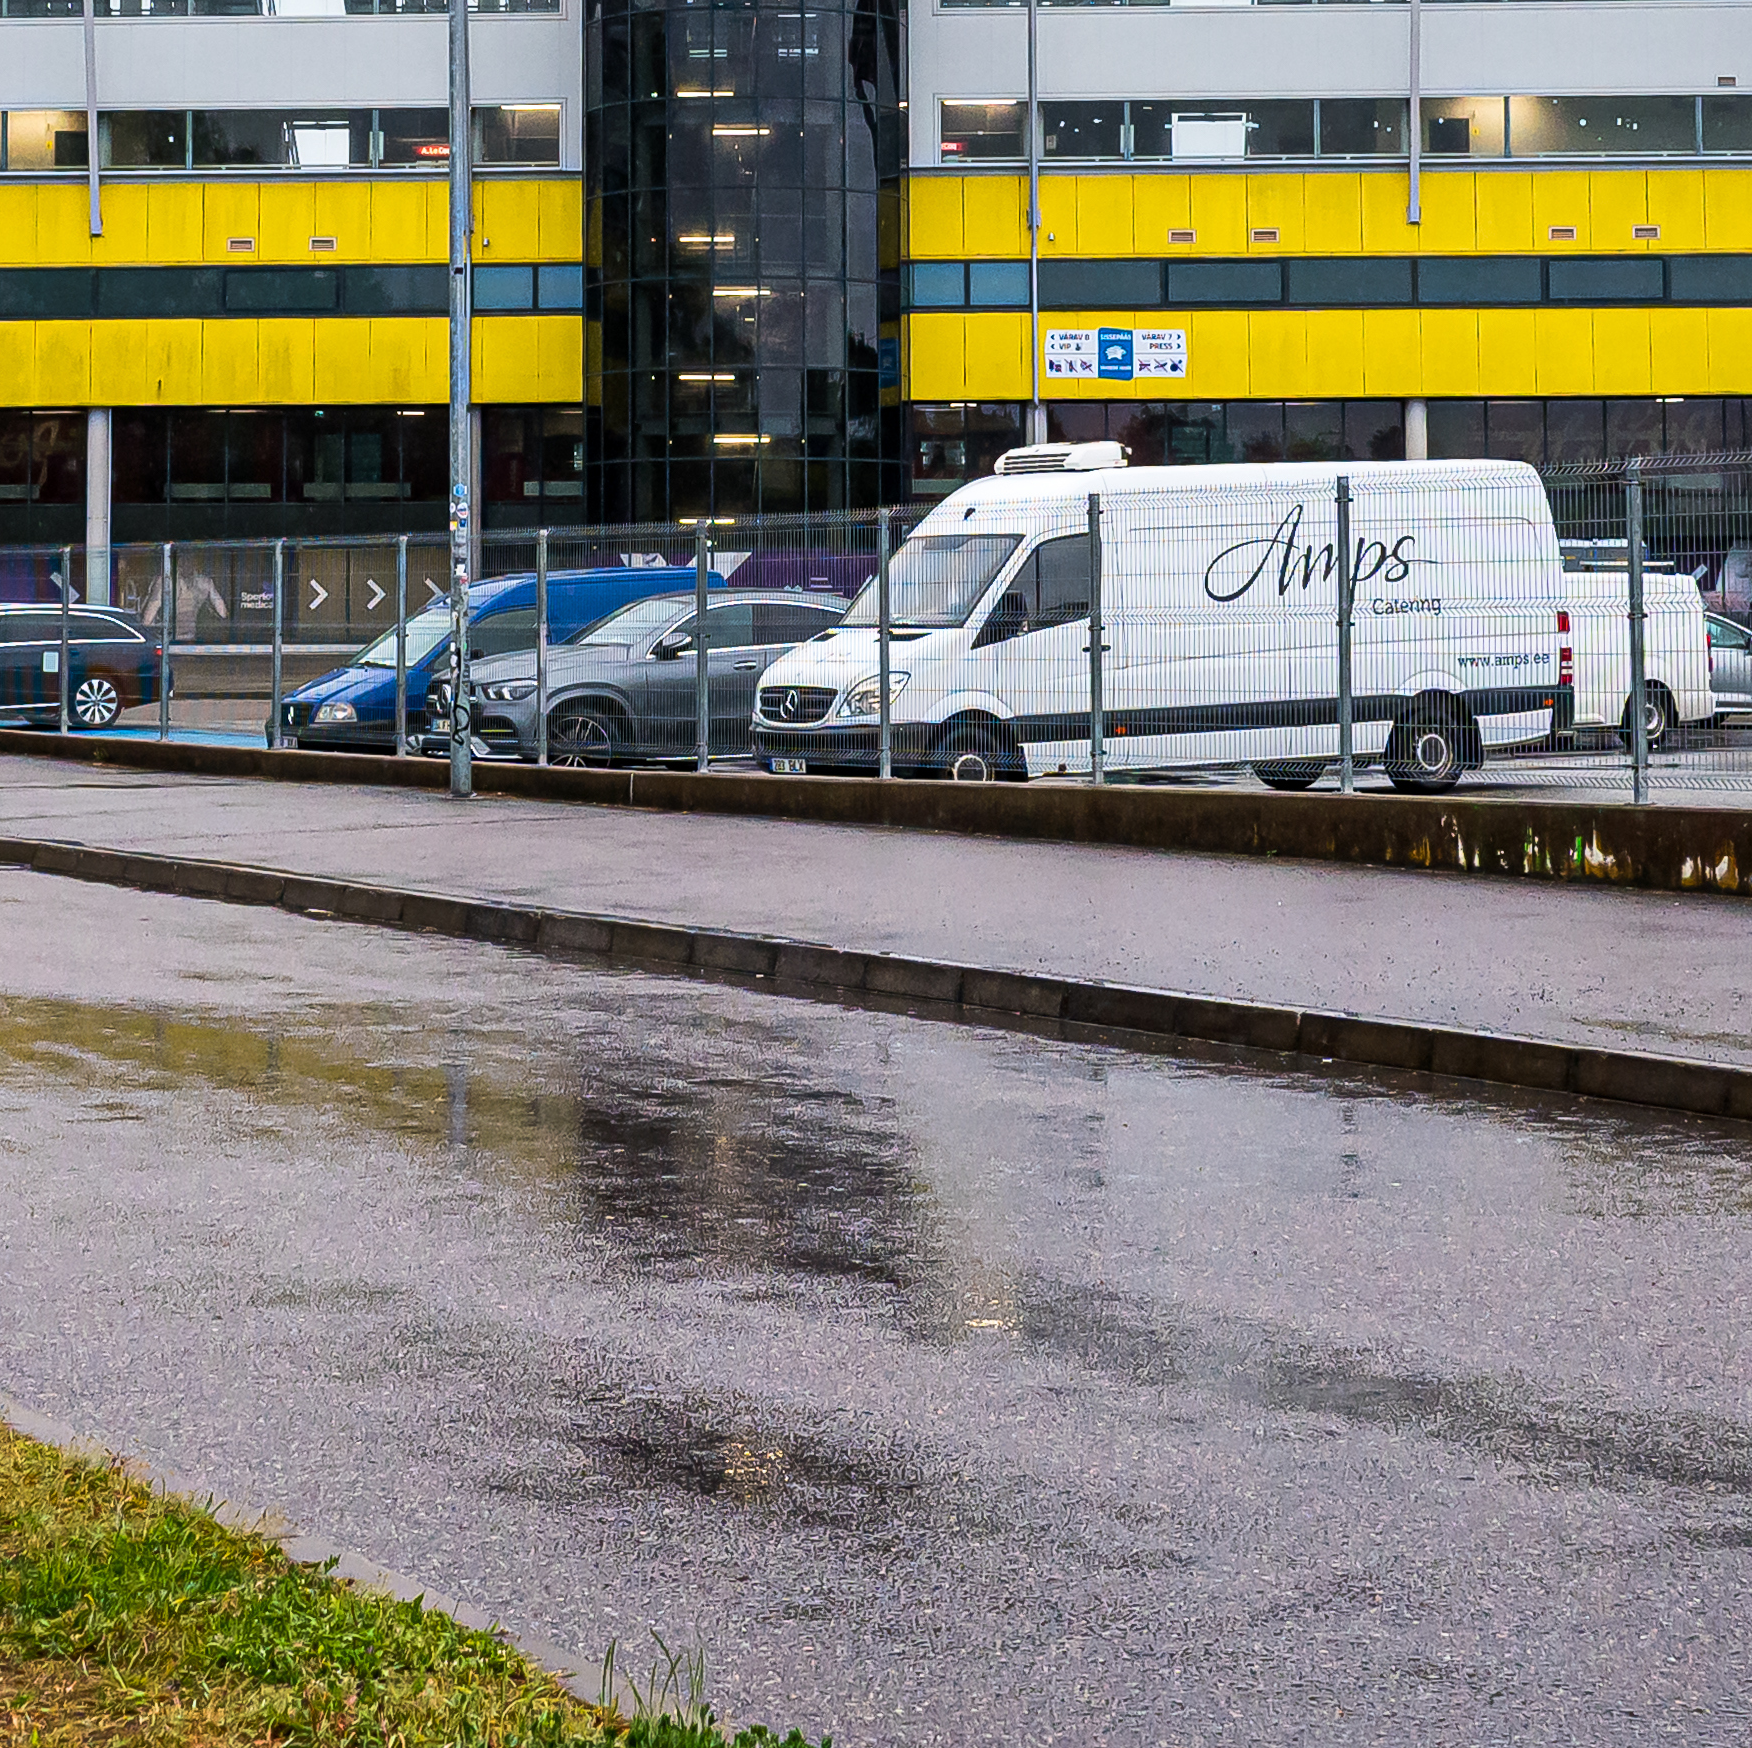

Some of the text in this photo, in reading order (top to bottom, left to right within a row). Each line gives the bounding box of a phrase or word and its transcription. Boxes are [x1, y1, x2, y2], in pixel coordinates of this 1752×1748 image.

[1058, 333, 1083, 341] VÄRAV
[1141, 333, 1165, 341] VÄRAV
[1205, 503, 1442, 616] Amps
[1372, 598, 1442, 616] Catering
[1457, 652, 1550, 669] www.amps.ee
